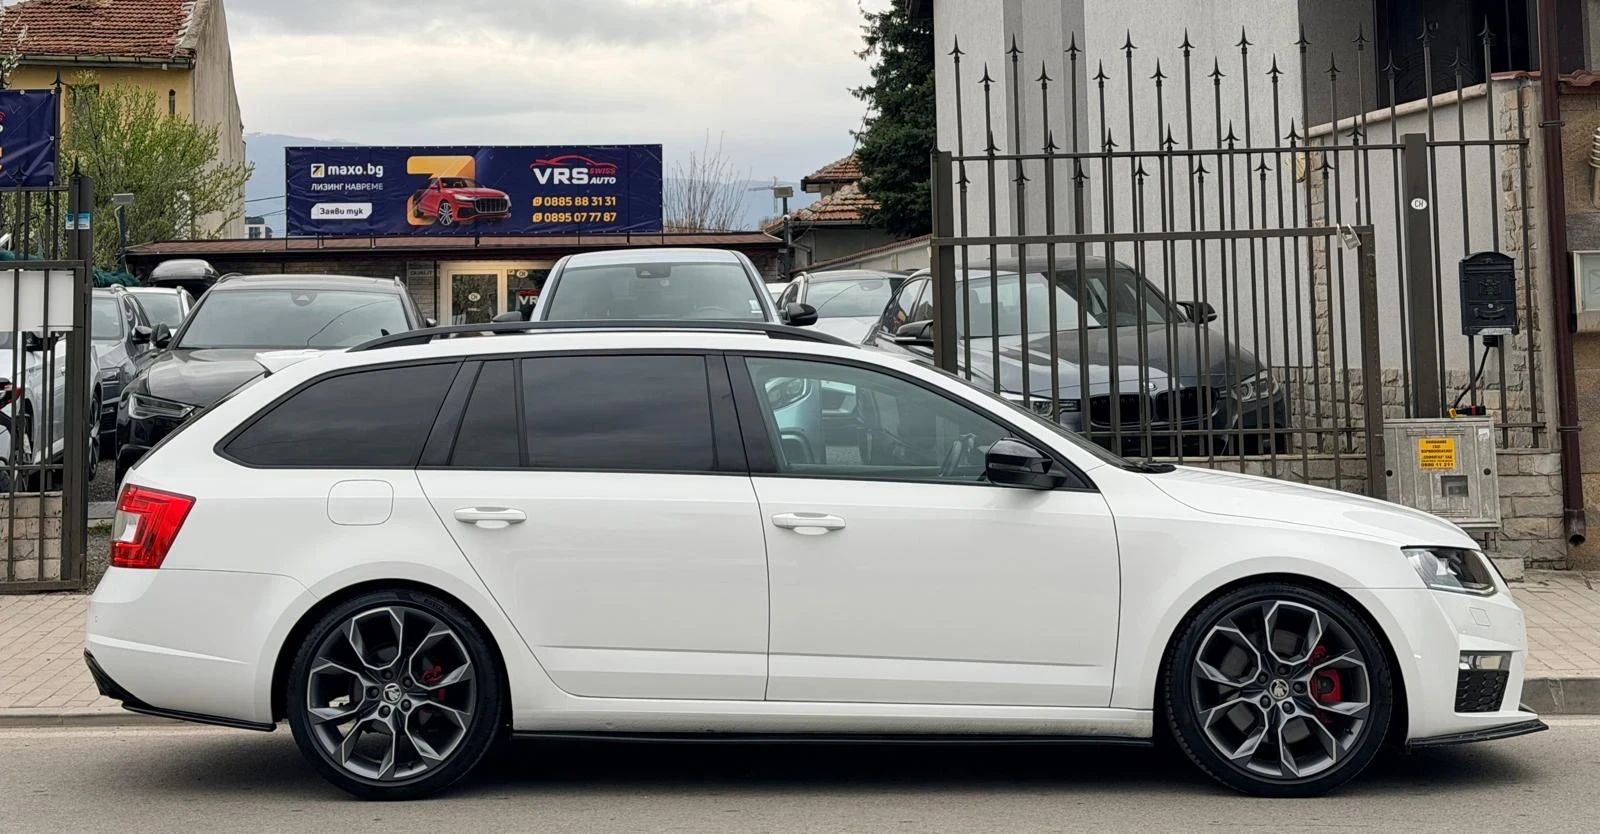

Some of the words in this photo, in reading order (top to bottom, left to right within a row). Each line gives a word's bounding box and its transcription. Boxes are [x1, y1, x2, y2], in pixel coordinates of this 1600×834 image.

[327, 163, 384, 178] maxo.bg
[533, 168, 589, 184] VRS
[311, 183, 344, 191] ЛИЗИНГ
[345, 183, 384, 191] НАВРЕМЕ
[544, 196, 573, 206] 0885
[574, 196, 589, 206] 88
[591, 196, 603, 206] 31
[604, 196, 616, 206] 31
[544, 212, 572, 222] 0895
[573, 212, 587, 222] 07
[588, 212, 602, 222] 77
[603, 212, 617, 222] 87
